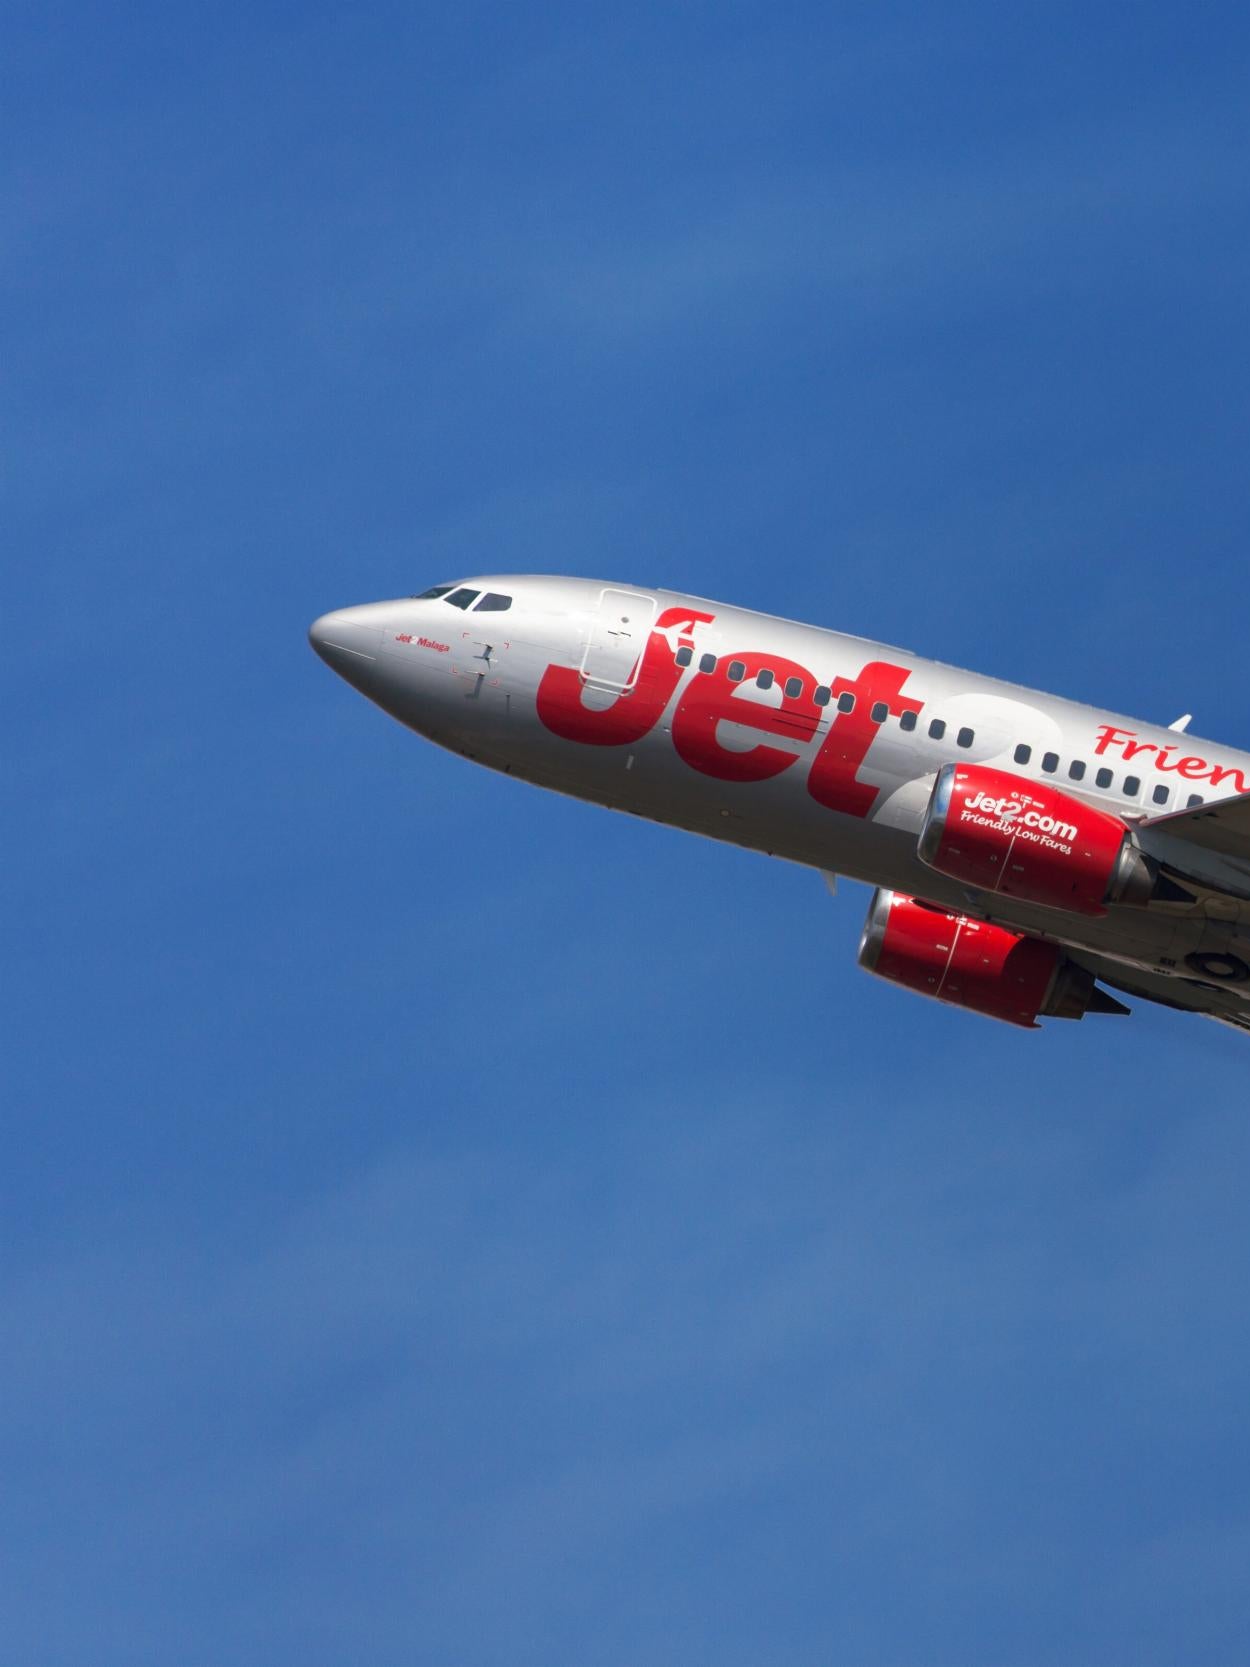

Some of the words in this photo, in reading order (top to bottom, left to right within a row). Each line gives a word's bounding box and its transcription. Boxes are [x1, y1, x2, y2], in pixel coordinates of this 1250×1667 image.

[960, 809, 1016, 836] Friendly
[1015, 826, 1041, 842] Low
[1039, 834, 1072, 855] Fares
[964, 791, 1078, 841] Jet2.com
